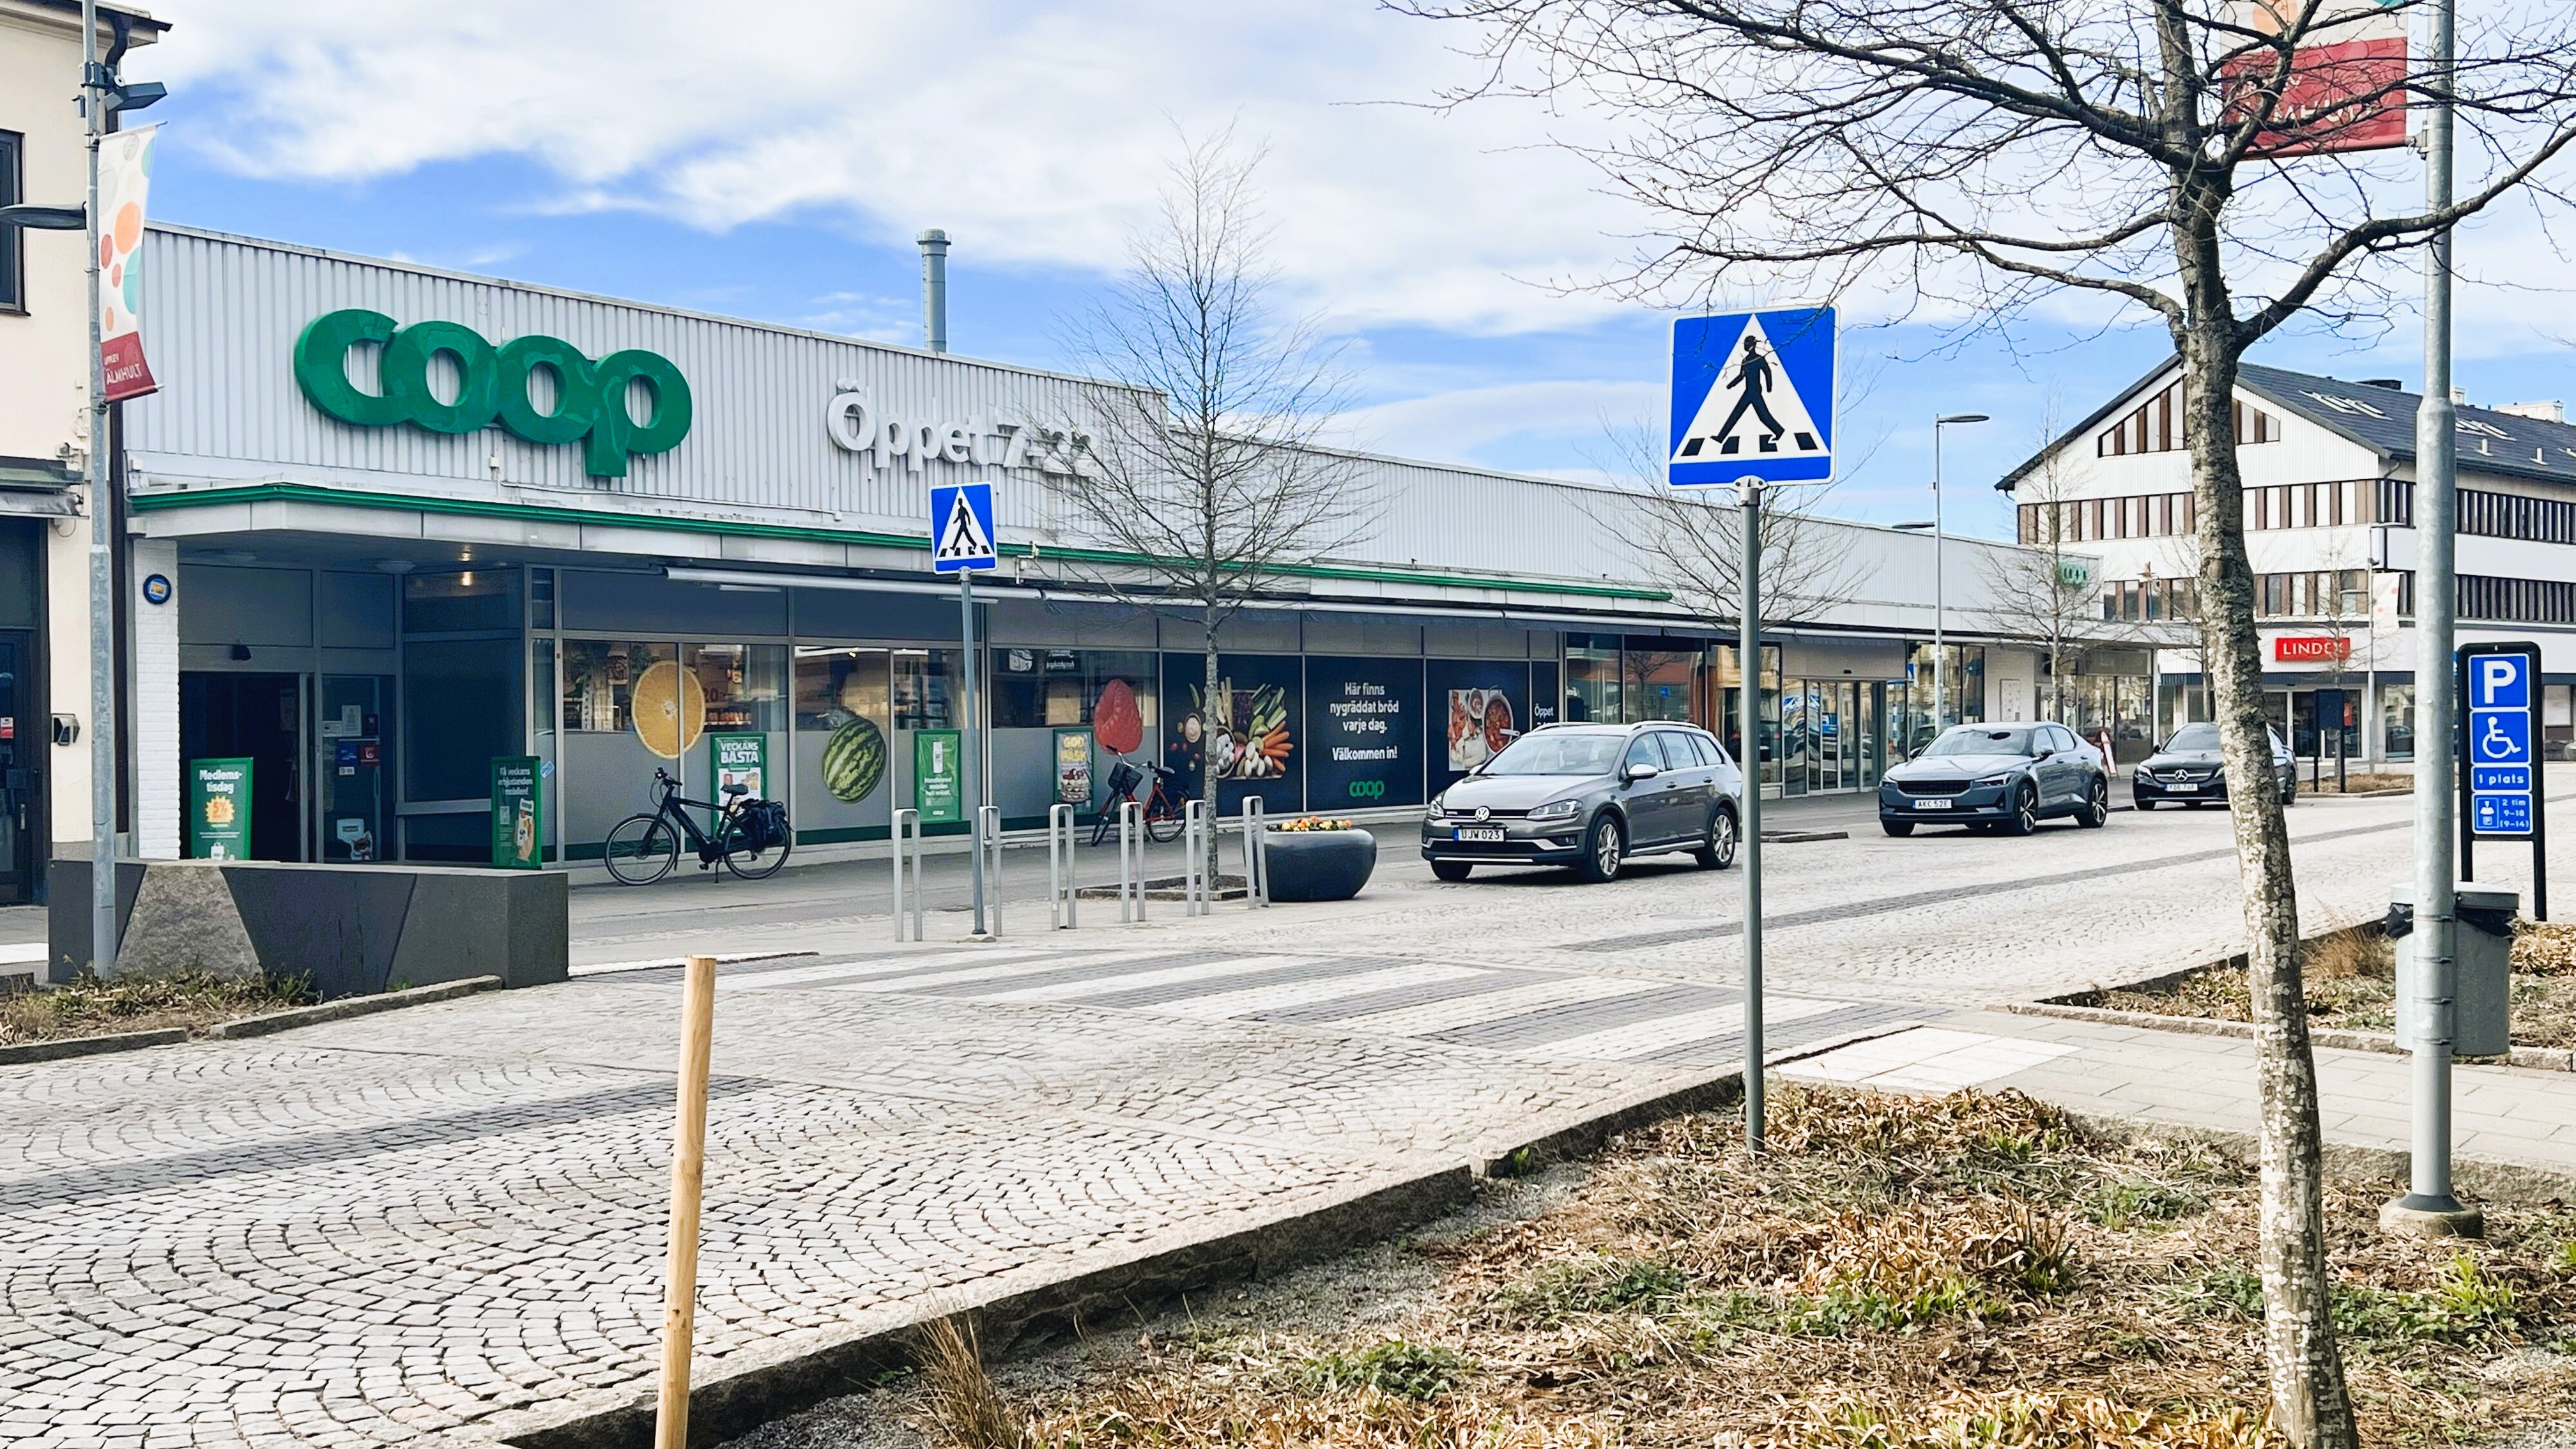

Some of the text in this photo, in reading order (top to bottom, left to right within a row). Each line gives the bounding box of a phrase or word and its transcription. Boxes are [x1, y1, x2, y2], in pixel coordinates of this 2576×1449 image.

[106, 364, 142, 385] ÄLMHULT
[294, 309, 692, 477] coop
[827, 378, 992, 471] Öppet
[1345, 682, 1384, 695] Här finns
[2483, 661, 2517, 704] P
[1330, 700, 1399, 717] nygräddat bröd
[1535, 703, 1554, 719] Öppet
[1343, 717, 1388, 734] varje dag.
[721, 742, 759, 751] VECKANS
[1332, 746, 1397, 761] Välkommen in!
[721, 751, 759, 763] BÄSTA
[199, 769, 242, 781] Medlems-
[2479, 774, 2524, 786] 1 plats
[206, 781, 234, 794] tisdag
[1349, 780, 1384, 799] coop
[1461, 830, 1500, 839] UJW 023
